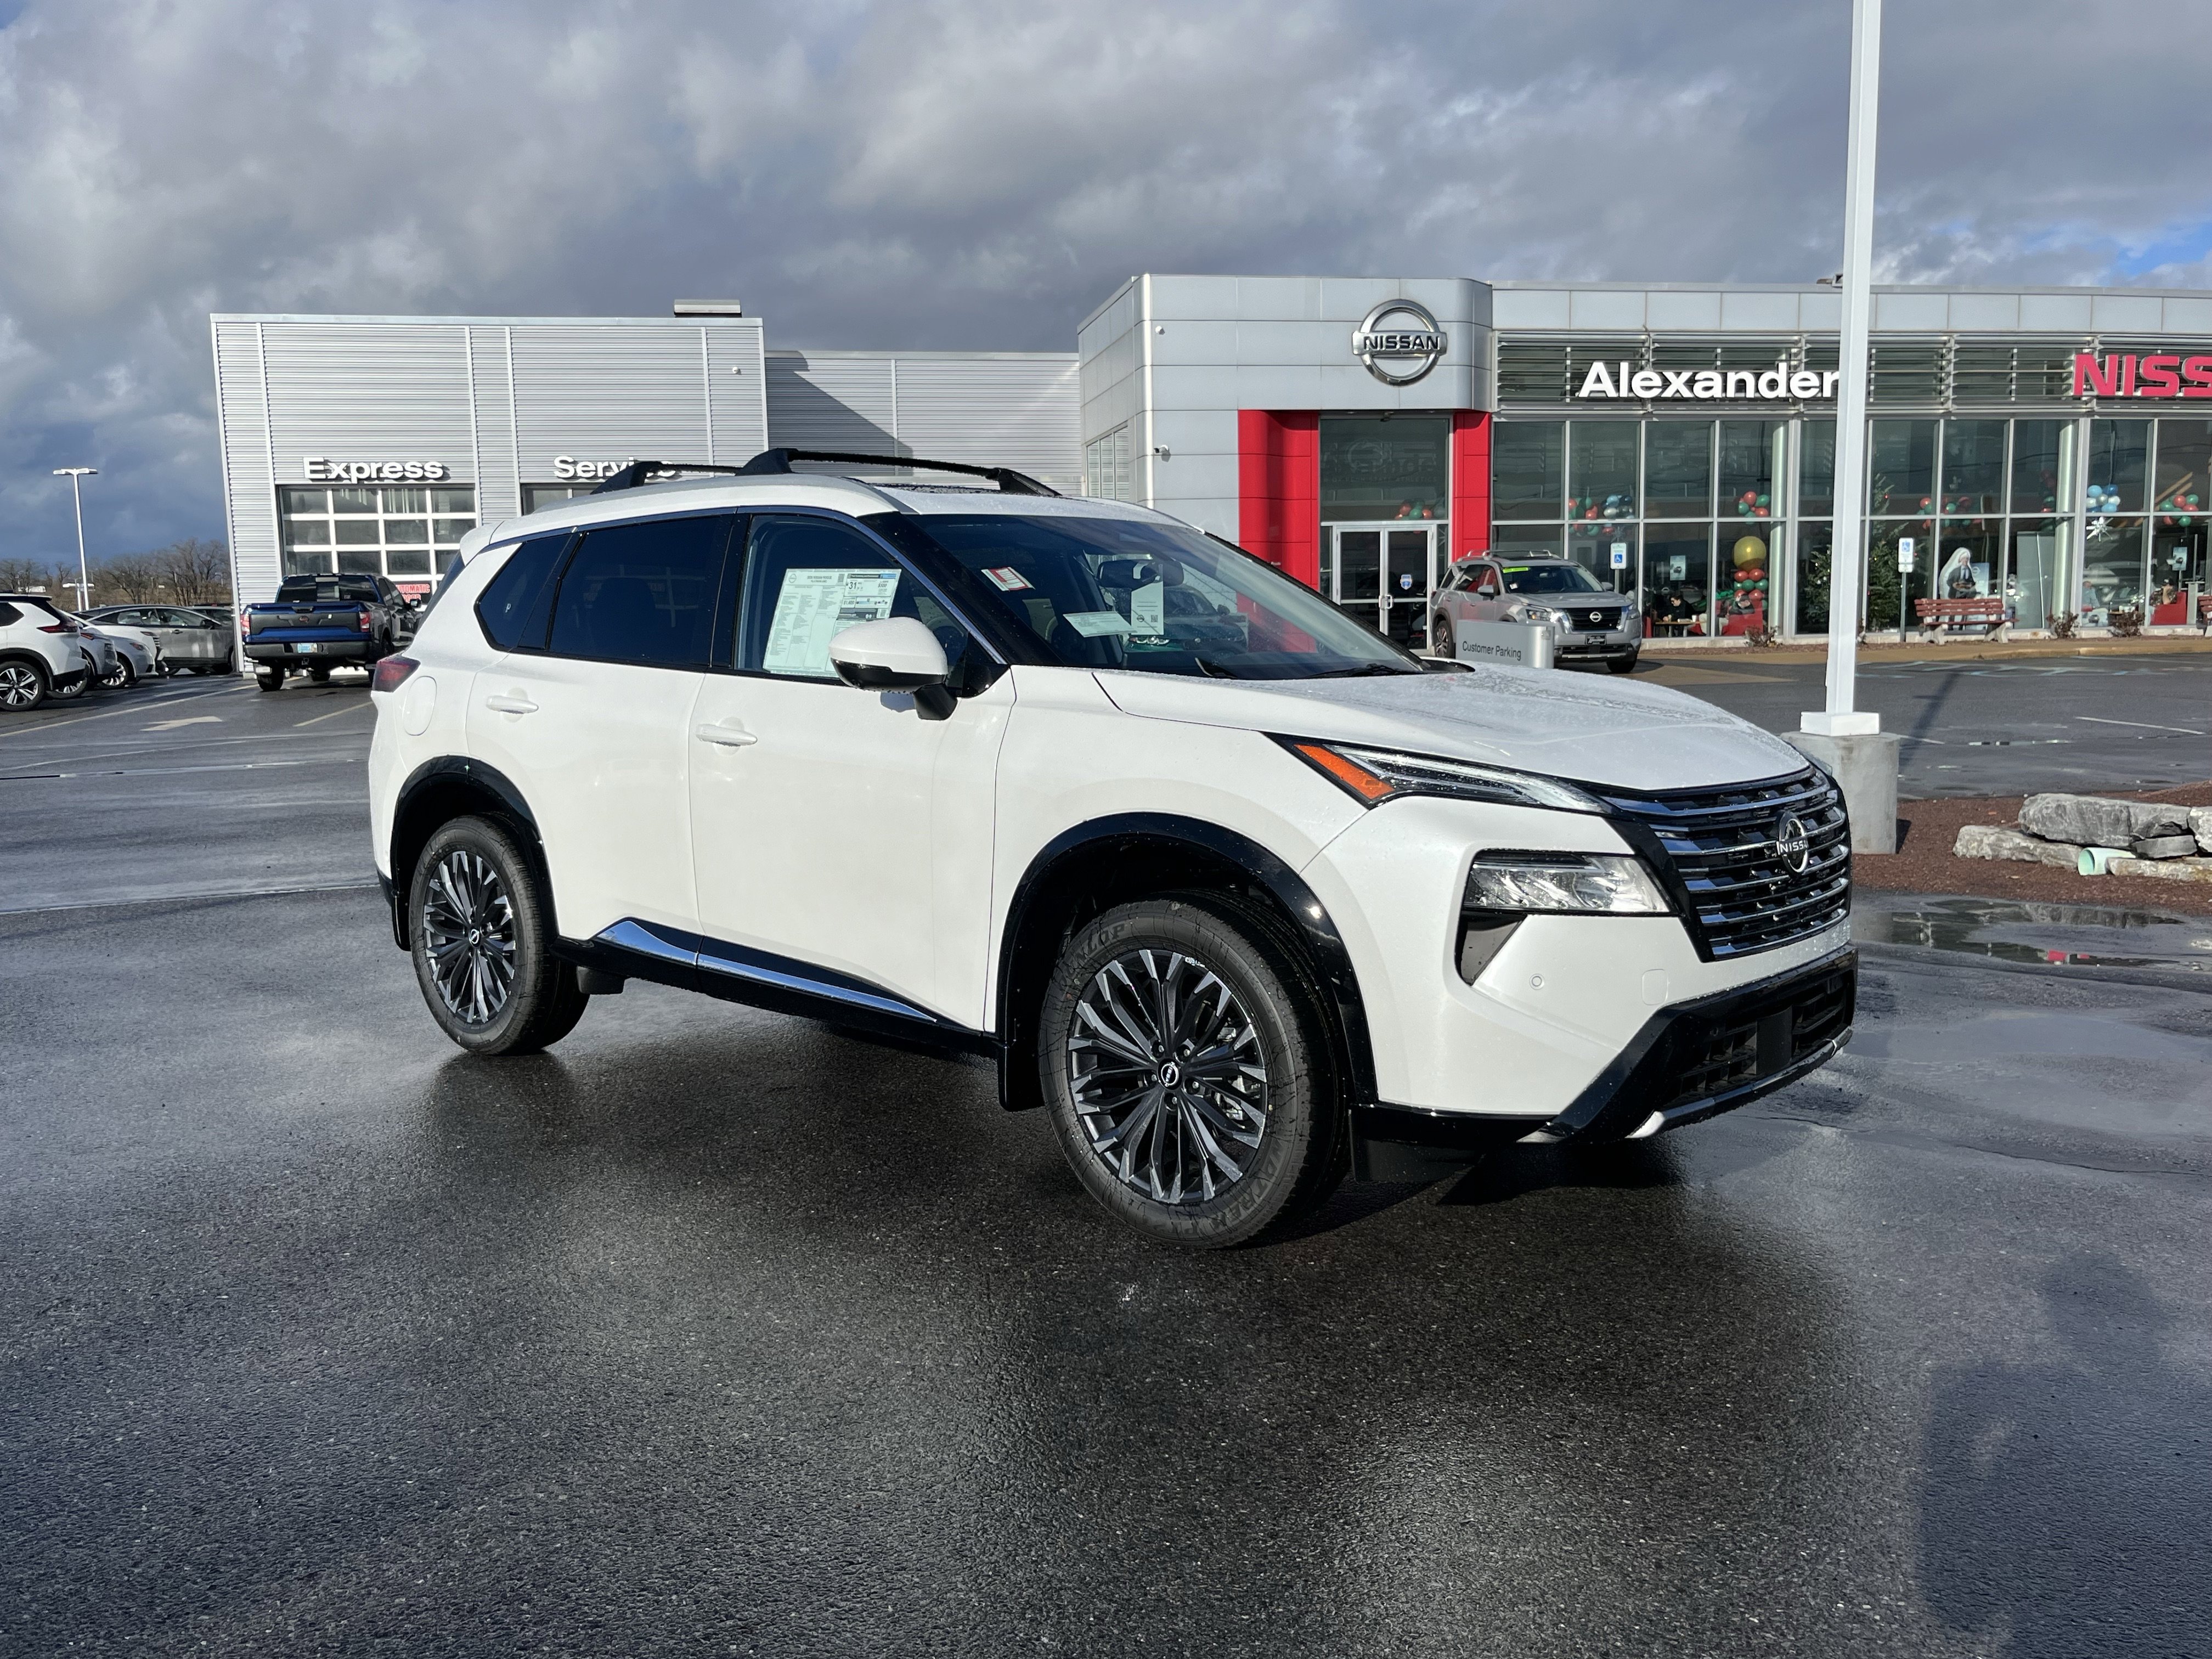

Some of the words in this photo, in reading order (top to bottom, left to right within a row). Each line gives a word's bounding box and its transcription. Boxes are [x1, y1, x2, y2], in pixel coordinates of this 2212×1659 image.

[1363, 335, 1441, 350] NISSAN
[1578, 362, 1839, 398] Alexander
[303, 457, 443, 484] Express
[1462, 640, 1494, 654] Customer
[1495, 645, 1522, 662] Parking
